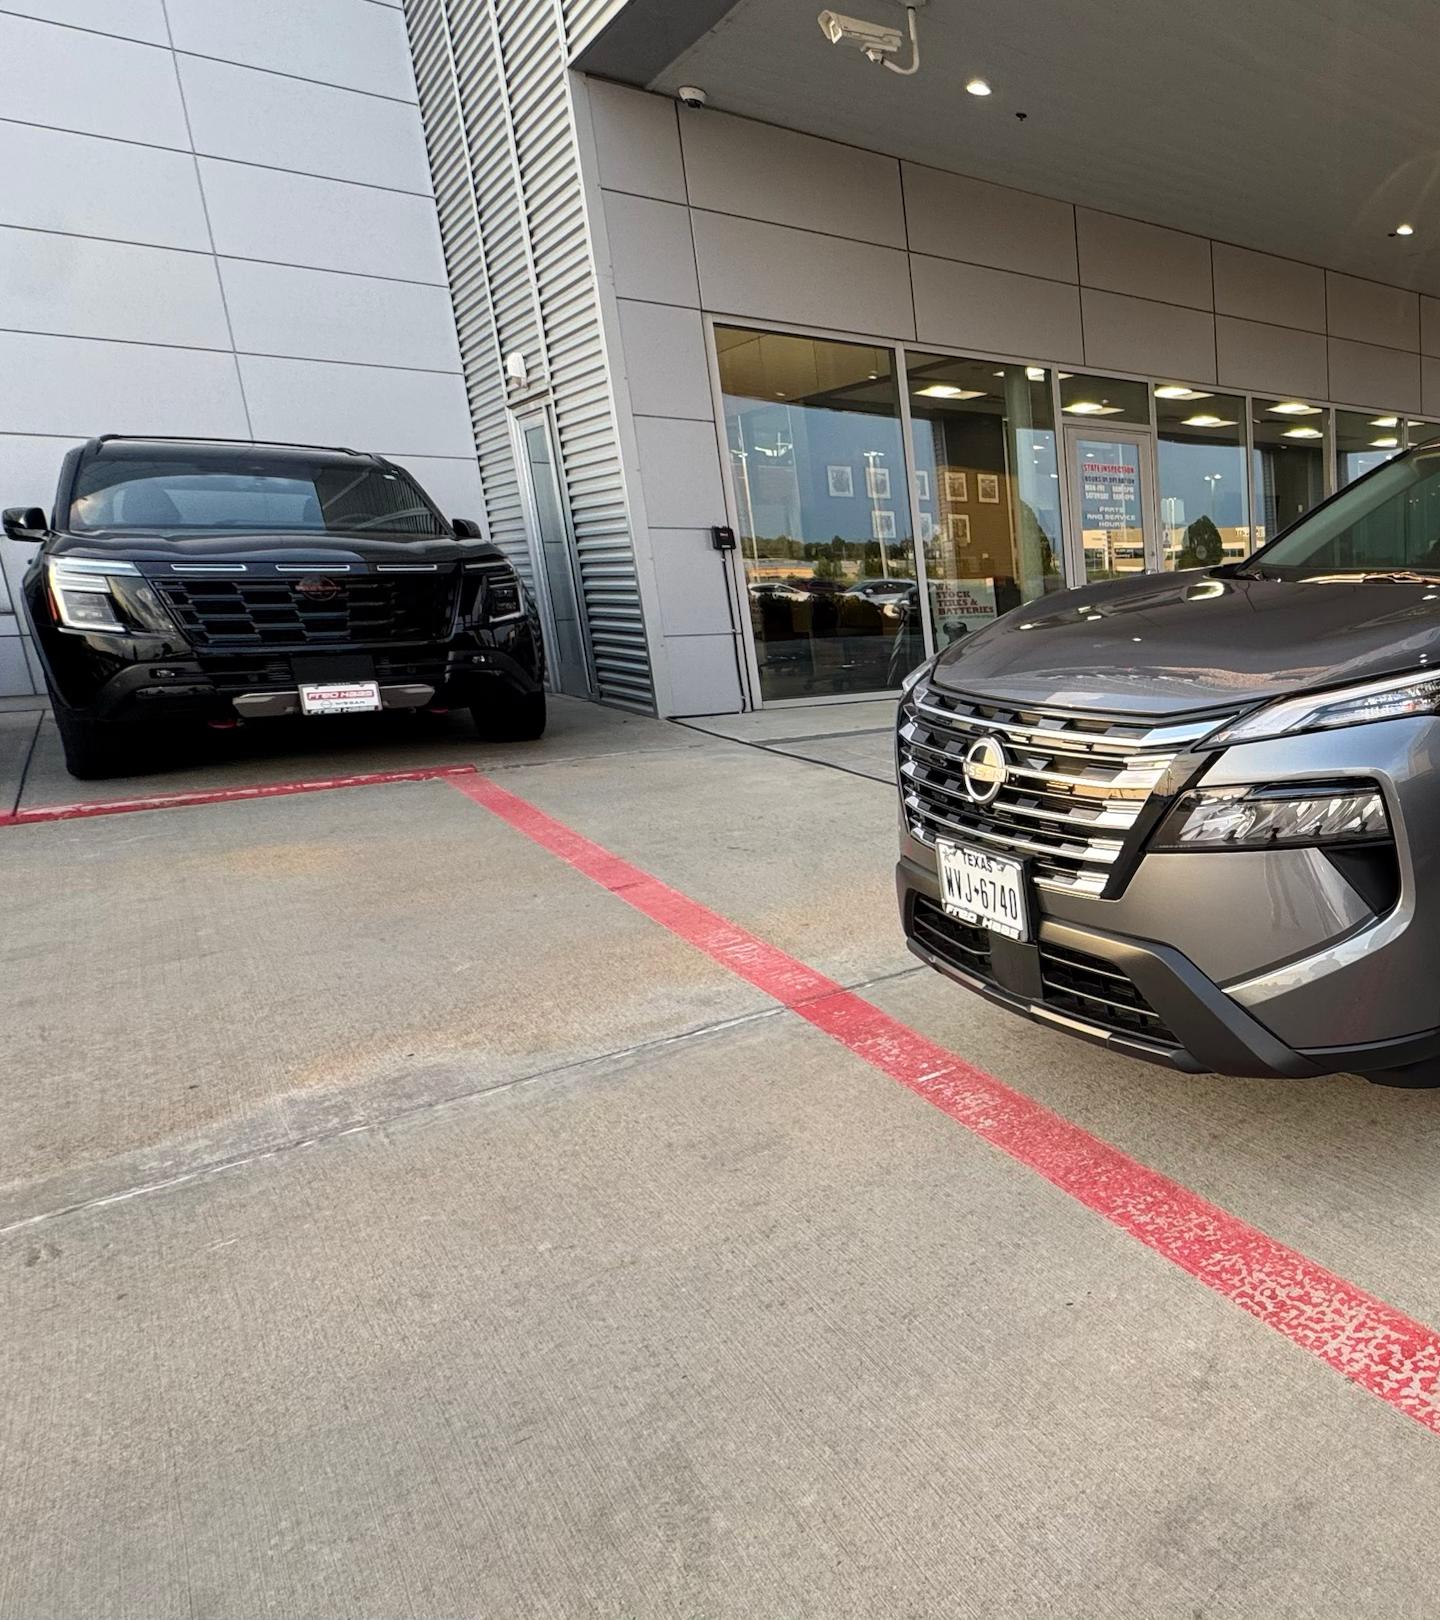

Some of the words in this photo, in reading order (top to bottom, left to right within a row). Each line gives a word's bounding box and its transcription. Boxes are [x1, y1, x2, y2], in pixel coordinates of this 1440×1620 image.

[1084, 464, 1100, 472] STATE
[1101, 465, 1134, 473] INSPECTION
[935, 591, 970, 599] STOCK
[937, 599, 968, 607] TIRES
[938, 606, 994, 615] BATTERIES
[963, 851, 992, 873] TEXAS
